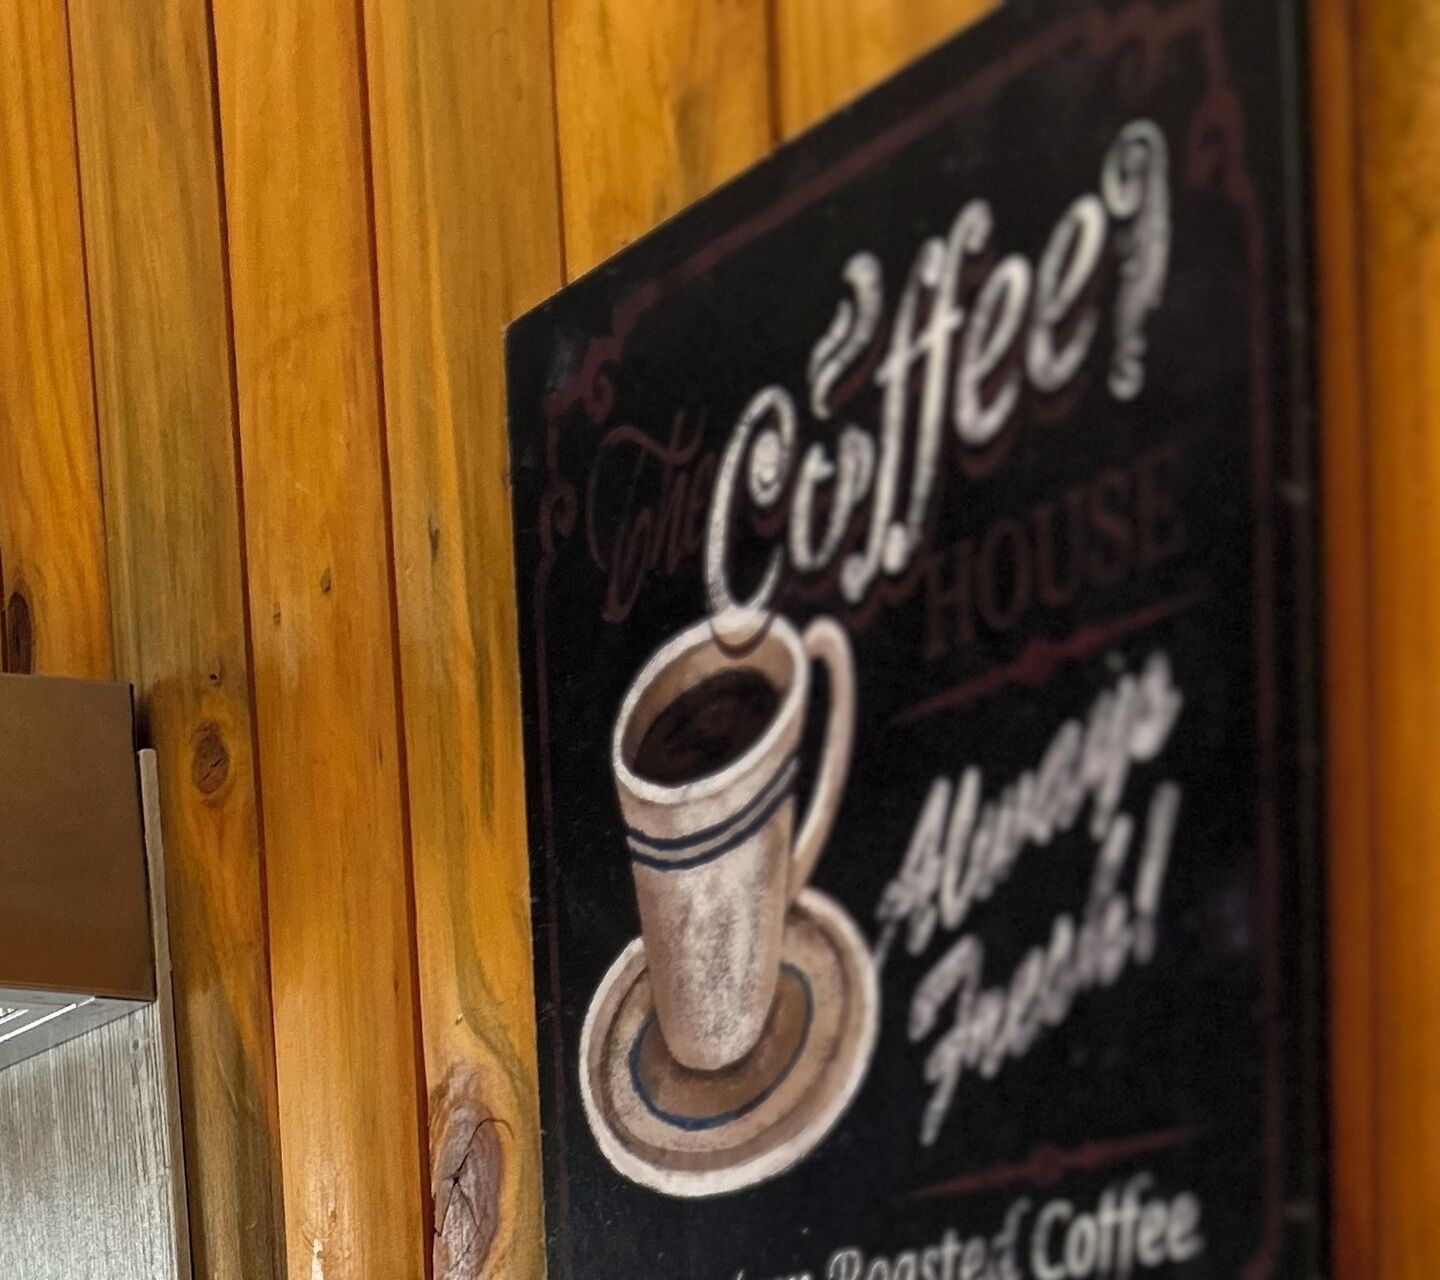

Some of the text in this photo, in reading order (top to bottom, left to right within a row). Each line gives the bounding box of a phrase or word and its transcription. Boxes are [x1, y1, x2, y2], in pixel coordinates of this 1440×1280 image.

[705, 119, 1169, 616] Coffee
[924, 444, 1187, 660] HOUSE
[873, 650, 1185, 975] Always
[907, 780, 1182, 1147] Fresh!
